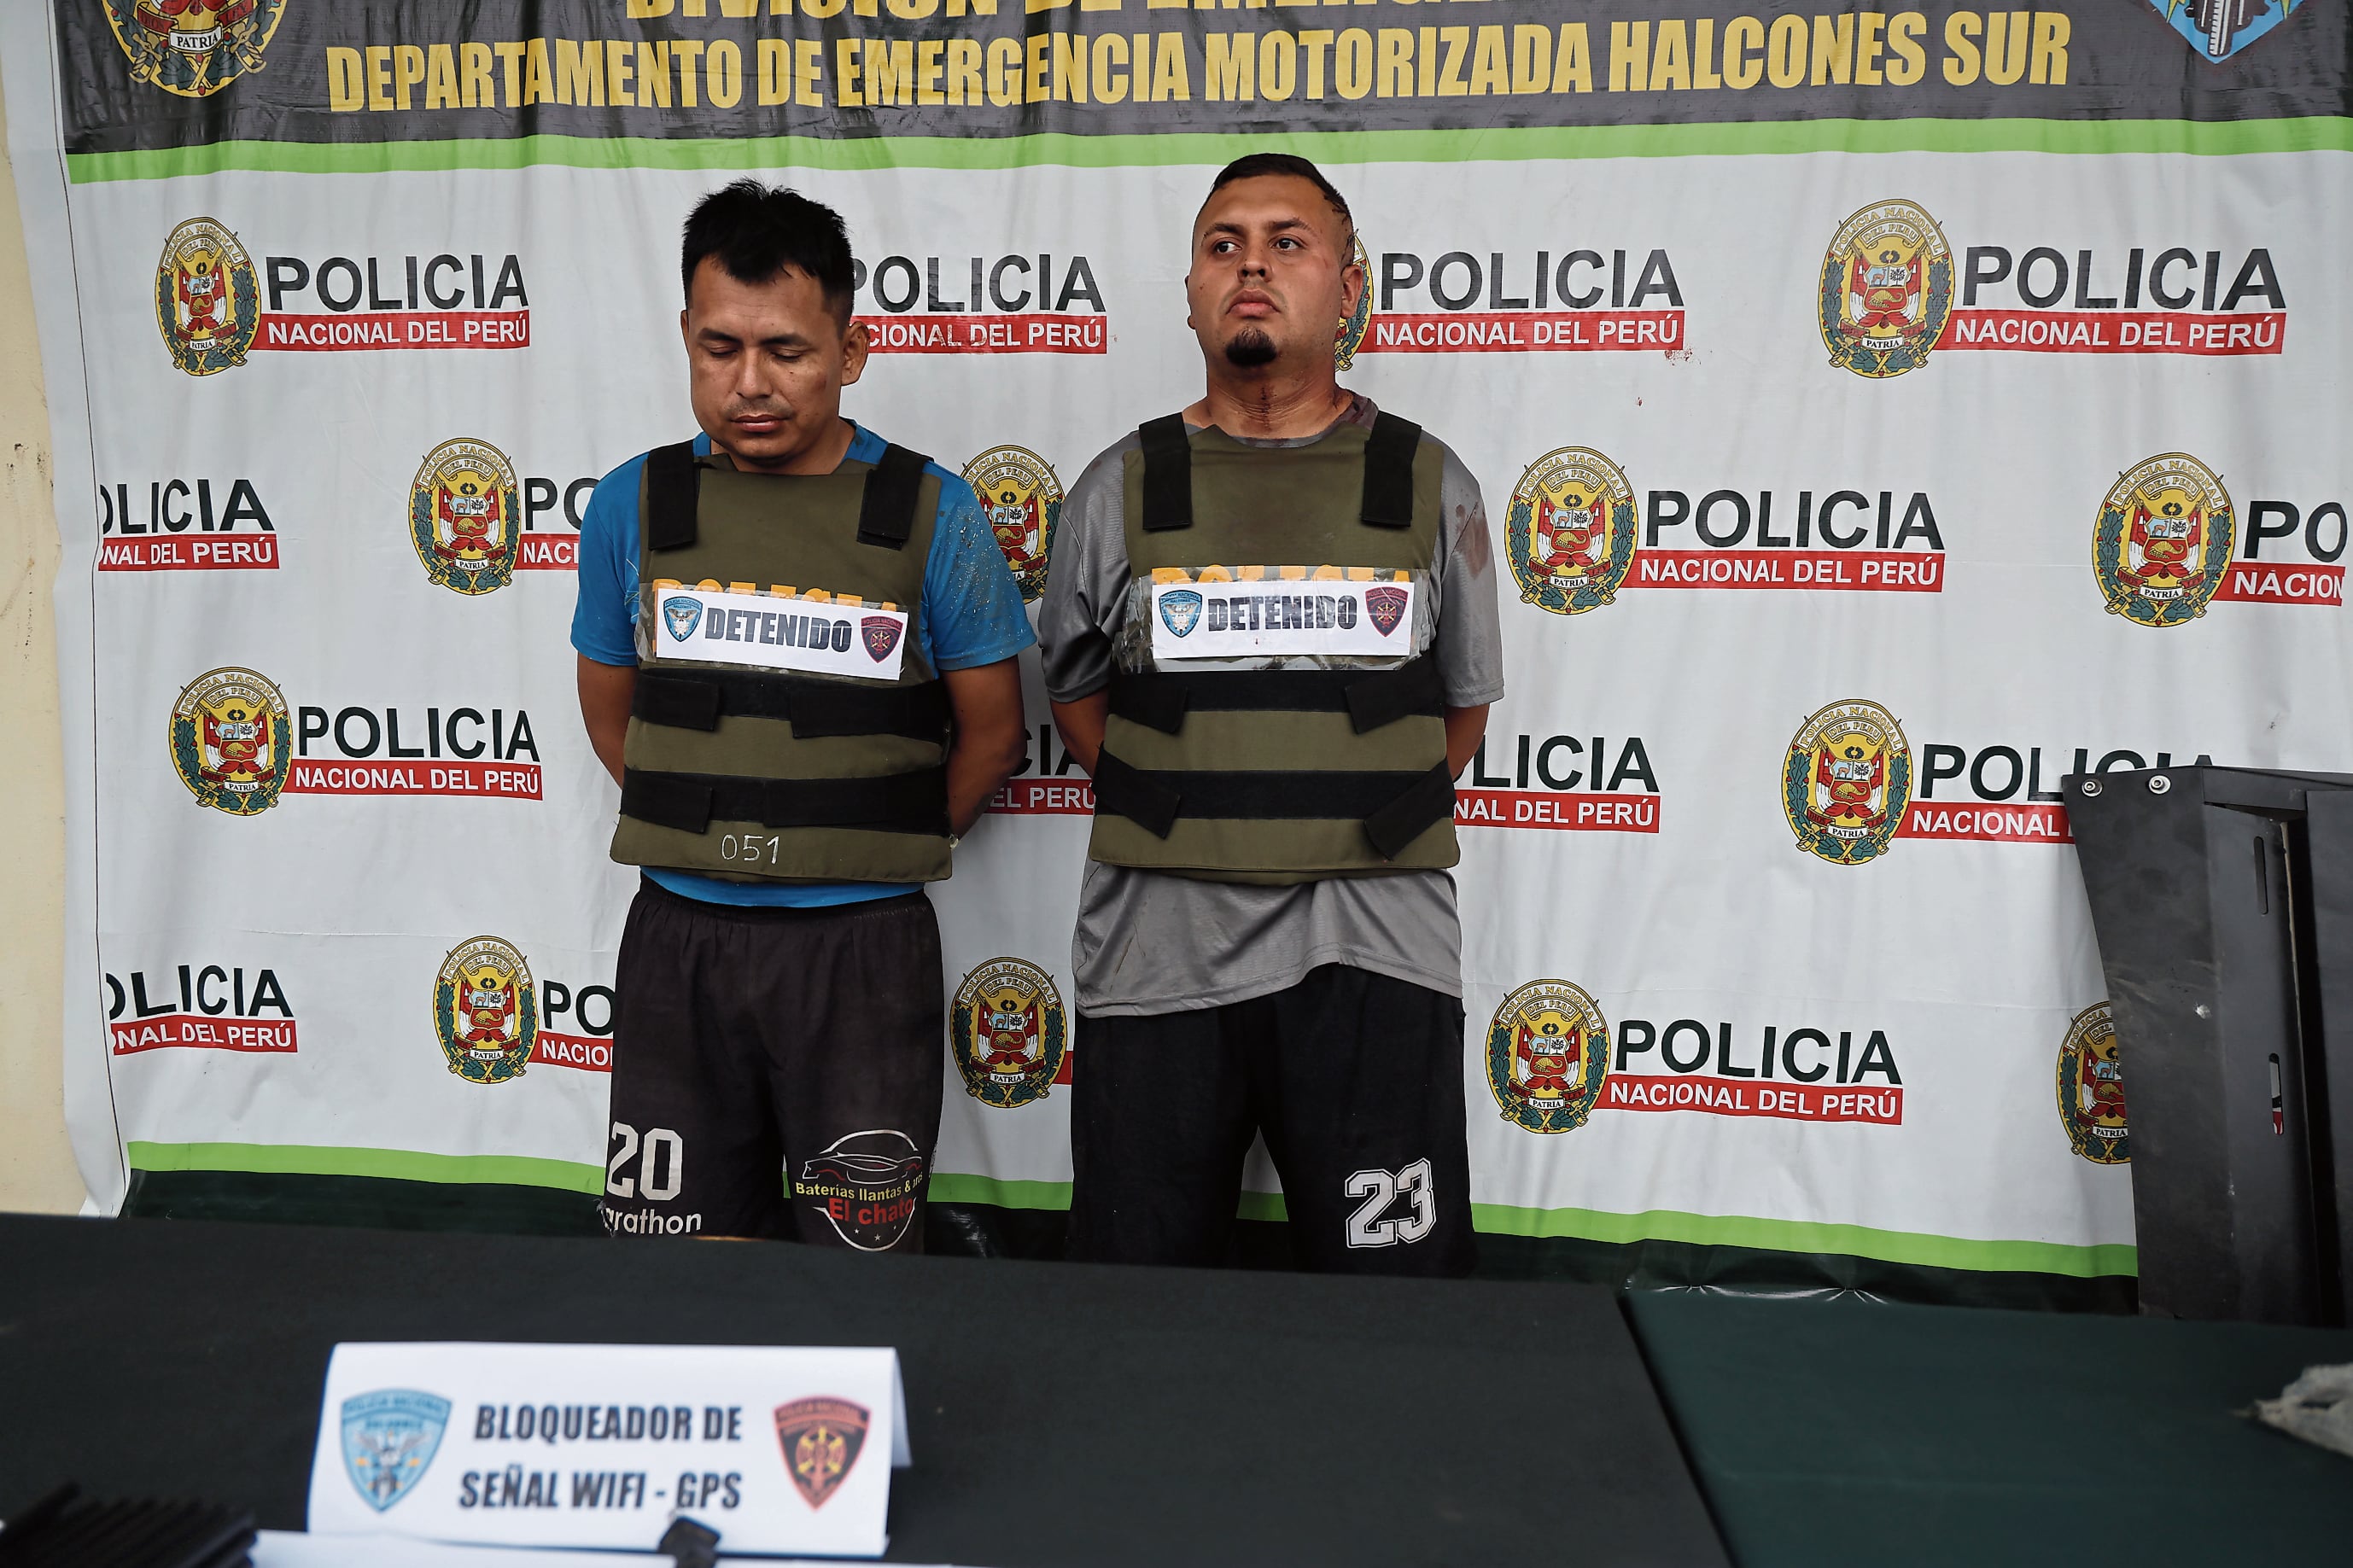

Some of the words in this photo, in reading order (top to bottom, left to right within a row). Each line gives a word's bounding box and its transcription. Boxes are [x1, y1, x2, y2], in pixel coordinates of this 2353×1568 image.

[177, 33, 219, 49] PATRIA
[328, 38, 740, 110] DEPARTAMENTO
[758, 39, 821, 105] DE
[838, 33, 1188, 105] EMERGENCIA
[1207, 24, 1591, 100] MOTORIZADA
[1610, 12, 1926, 90] HALCONES
[1945, 11, 2070, 84] SUR
[1836, 211, 1881, 253] POLICIA
[1883, 207, 1943, 254] NACIONAL
[1864, 227, 1886, 242] DEL
[266, 254, 528, 312] POLICIA
[1381, 249, 1684, 310] POLICIA
[1963, 247, 2286, 312] POLICIA
[268, 322, 400, 344] NACIONAL
[408, 321, 456, 341] DEL
[464, 314, 527, 343] PERÚ
[971, 324, 1020, 346] DEL
[1029, 319, 1101, 347] PERÚ
[1377, 322, 1524, 346] NACIONAL
[1533, 321, 1591, 345] DEL
[1598, 313, 1679, 345] PERÚ
[1956, 319, 2109, 345] NACIONAL
[2120, 323, 2181, 346] DEL
[2189, 316, 2276, 347] PERÚ
[1866, 340, 1900, 348] PATRIA
[444, 461, 463, 474] DEL
[965, 453, 1000, 485] OLICIA
[1002, 452, 1057, 493] NACIONAL
[986, 469, 1005, 483] DEL
[1521, 456, 1564, 496] POLICIA
[1567, 453, 1626, 496] NACIONAL
[1548, 470, 1568, 486] DEL
[1571, 469, 1598, 485] PERU
[2114, 463, 2165, 503] POLICIA
[2169, 460, 2223, 506] NACIONAL
[2146, 478, 2169, 493] DEL
[1646, 490, 1944, 550] POLICIA
[151, 544, 185, 564] DEL
[193, 537, 272, 562] PERÚ
[459, 560, 486, 569] PATRIA
[1554, 578, 1585, 586] PATRIA
[1641, 559, 1784, 581] NACIONAL
[1794, 560, 1851, 582] DEL
[1861, 557, 1936, 585] PERÚ
[2144, 589, 2179, 597] PATRIA
[1207, 595, 1358, 632] DETENIDO
[704, 607, 853, 653] DETENIDO
[181, 674, 223, 713] POLICIA
[225, 673, 283, 712] NACIONAL
[209, 689, 230, 702] DEL
[298, 706, 540, 762] POLICIA
[1801, 708, 1846, 747] POLICIA
[1848, 706, 1901, 749] NACIONAL
[1829, 723, 1850, 737] DEL
[1853, 721, 1879, 737] PERU
[1472, 735, 1660, 792] LICIA
[229, 783, 256, 791] PATRIA
[296, 767, 423, 788] NACIONAL
[429, 769, 479, 790] DEL
[485, 768, 539, 794] PERÚ
[1515, 801, 1568, 823] DEL
[1579, 799, 1653, 825] PERÚ
[1912, 811, 2059, 836] NACIONAL
[1832, 828, 1864, 837] PATRIA
[721, 834, 780, 864] 051
[467, 956, 485, 970] DEL
[961, 965, 1000, 1001] POLICIA
[1001, 963, 1055, 1001] NACIONAL
[986, 978, 1005, 992] DEL
[1500, 987, 1543, 1022] POLICIA
[1544, 986, 1601, 1027] NACIONAL
[1527, 1000, 1547, 1015] DEL
[1549, 1000, 1575, 1015] PERU
[183, 1023, 224, 1042] DEL
[227, 1023, 290, 1046] PERÚ
[2069, 1009, 2108, 1047] POLICIA
[2092, 1023, 2112, 1038] DEL
[474, 1050, 501, 1059] PATRIA
[1614, 1019, 1902, 1085] POLICIA
[994, 1075, 1022, 1083] PATRIA
[1532, 1099, 1561, 1108] PATRIA
[1611, 1082, 1749, 1109] NACIONAL
[1759, 1090, 1813, 1114] DEL
[1822, 1091, 1895, 1117] PERÚ
[2096, 1128, 2128, 1137] PATRIA
[607, 1121, 683, 1201] 20
[796, 1182, 855, 1199] Baterías
[859, 1186, 902, 1201] llantas
[904, 1180, 911, 1193] &
[1345, 1157, 1437, 1249] 23
[828, 1198, 850, 1221] El
[858, 1197, 914, 1225] chato
[474, 1404, 691, 1443] BLOQUEADOR
[703, 1405, 743, 1442] DE
[458, 1464, 558, 1509] SEÑAL
[570, 1472, 645, 1509] WIFI
[675, 1471, 743, 1509] GPS
